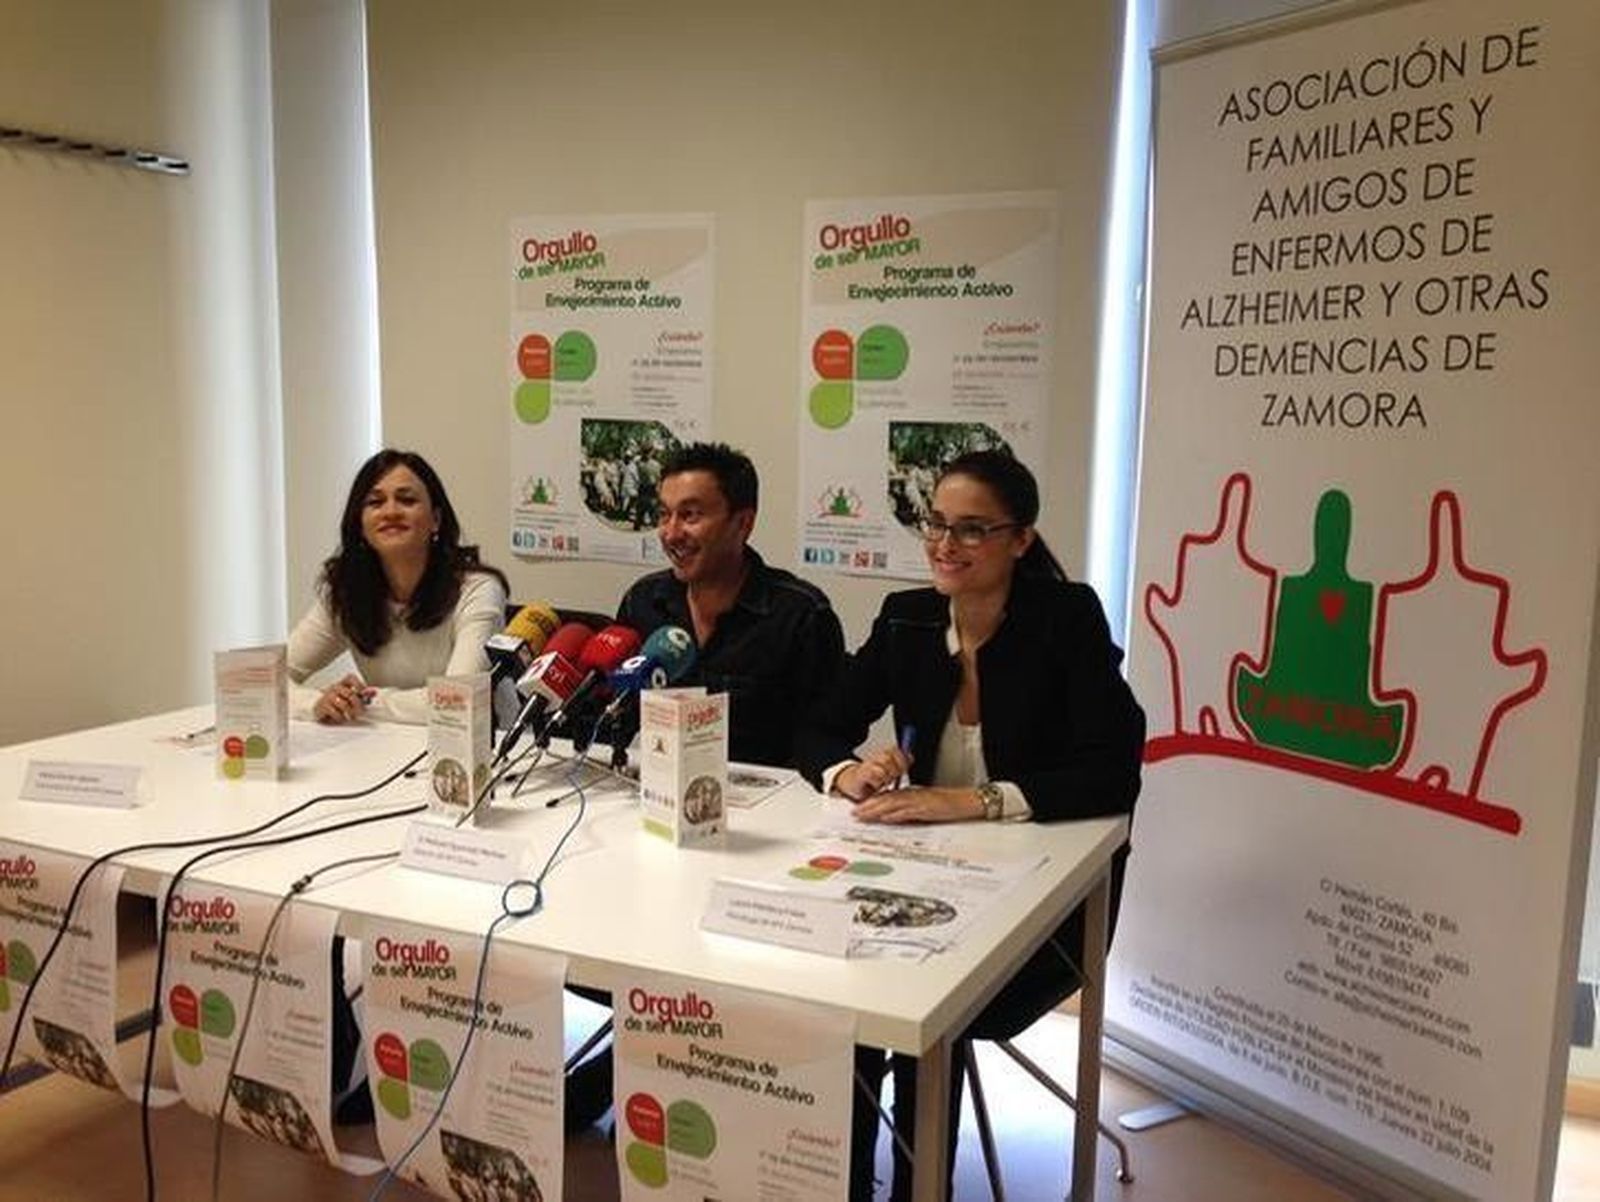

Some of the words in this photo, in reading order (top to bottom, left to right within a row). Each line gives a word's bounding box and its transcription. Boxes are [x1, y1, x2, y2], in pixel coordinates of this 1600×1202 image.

[1218, 40, 1466, 126] ASOCIACIÓN
[1482, 26, 1539, 73] DE
[1247, 103, 1454, 171] FAMILIARES
[1470, 95, 1492, 134] Y
[1253, 168, 1407, 222] AMIGOS
[1423, 158, 1475, 200] DE
[523, 231, 597, 264] Orgullo
[820, 213, 911, 252] Orgullo
[1232, 222, 1426, 276] ENFERMOS
[1441, 214, 1494, 256] DE
[814, 254, 833, 270] de
[883, 265, 953, 285] Programa
[957, 264, 976, 280] de
[575, 278, 632, 294] Programa
[635, 277, 650, 291] de
[639, 295, 682, 308] Activo
[962, 282, 1013, 298] Activo
[1181, 284, 1365, 330] ALZHEIMER
[1380, 281, 1401, 317] Y
[1415, 269, 1549, 315] OTRAS
[1214, 335, 1429, 376] DEMENCIAS
[1444, 333, 1496, 370] DE
[1261, 392, 1427, 428] ZAMORA
[169, 895, 236, 921] Orgullo
[376, 936, 450, 966] Orgullo
[629, 987, 714, 1021] Orgullo
[624, 1017, 642, 1032] de
[671, 1019, 723, 1038] MAYOR
[689, 1043, 756, 1073] Programa
[759, 1061, 778, 1079] de
[764, 1081, 815, 1106] Activo
